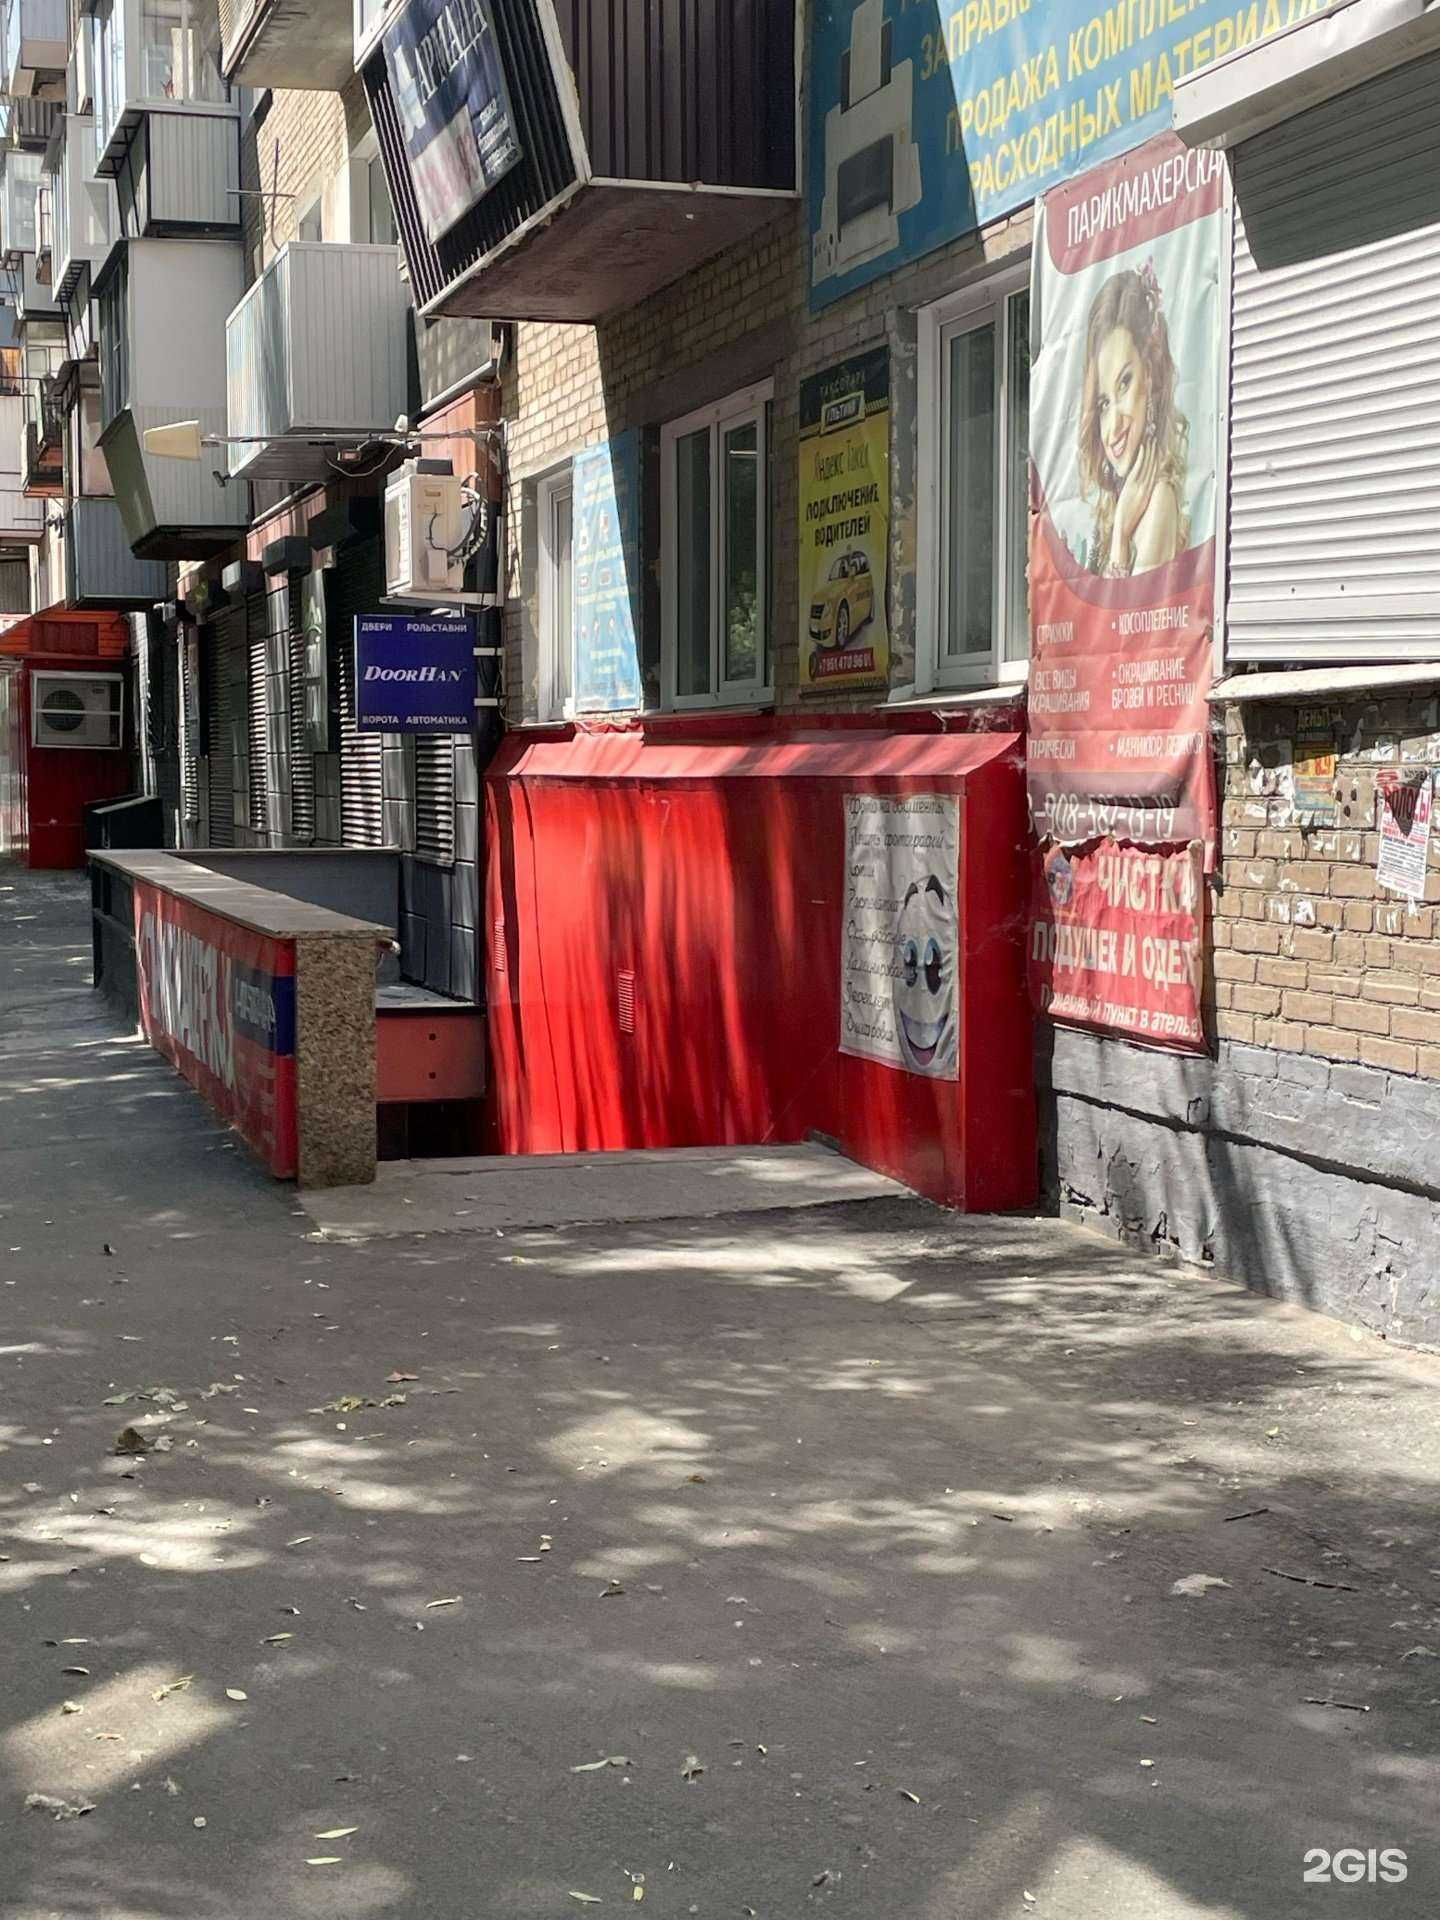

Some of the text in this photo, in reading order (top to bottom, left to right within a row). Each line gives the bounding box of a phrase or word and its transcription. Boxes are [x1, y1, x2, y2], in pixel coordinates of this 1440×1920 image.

[946, 0, 1207, 156] ПРОДАЖА КОМПЛЕ
[968, 78, 1123, 201] РАСХОДНЫХ
[806, 483, 880, 522] ПОДКЛЮЧЕНИЕ
[815, 511, 870, 548] ВОДИТЕЛЕЙ
[361, 623, 467, 632] ДВЕРИ РОЛЬСТАВНИ
[1036, 622, 1074, 645] СТРИЖКИ
[1119, 605, 1189, 635] КОСОПЛЕТЕНИЕ
[1034, 669, 1077, 691] ВСЕ ВИДЫ
[1118, 657, 1186, 685] ОКРАШИВАНИЕ
[1112, 685, 1145, 710] БРОВЕЙ
[1146, 688, 1154, 707] И
[363, 716, 468, 724] ВОРОТА АВТОМАТИКА
[1029, 739, 1076, 760] ПРИЧЕСКИ
[1098, 855, 1194, 915] ЧИСТКА
[1032, 921, 1119, 976] ПОДУШЕК
[1121, 933, 1137, 978] И
[1104, 1001, 1138, 1028] пункт
